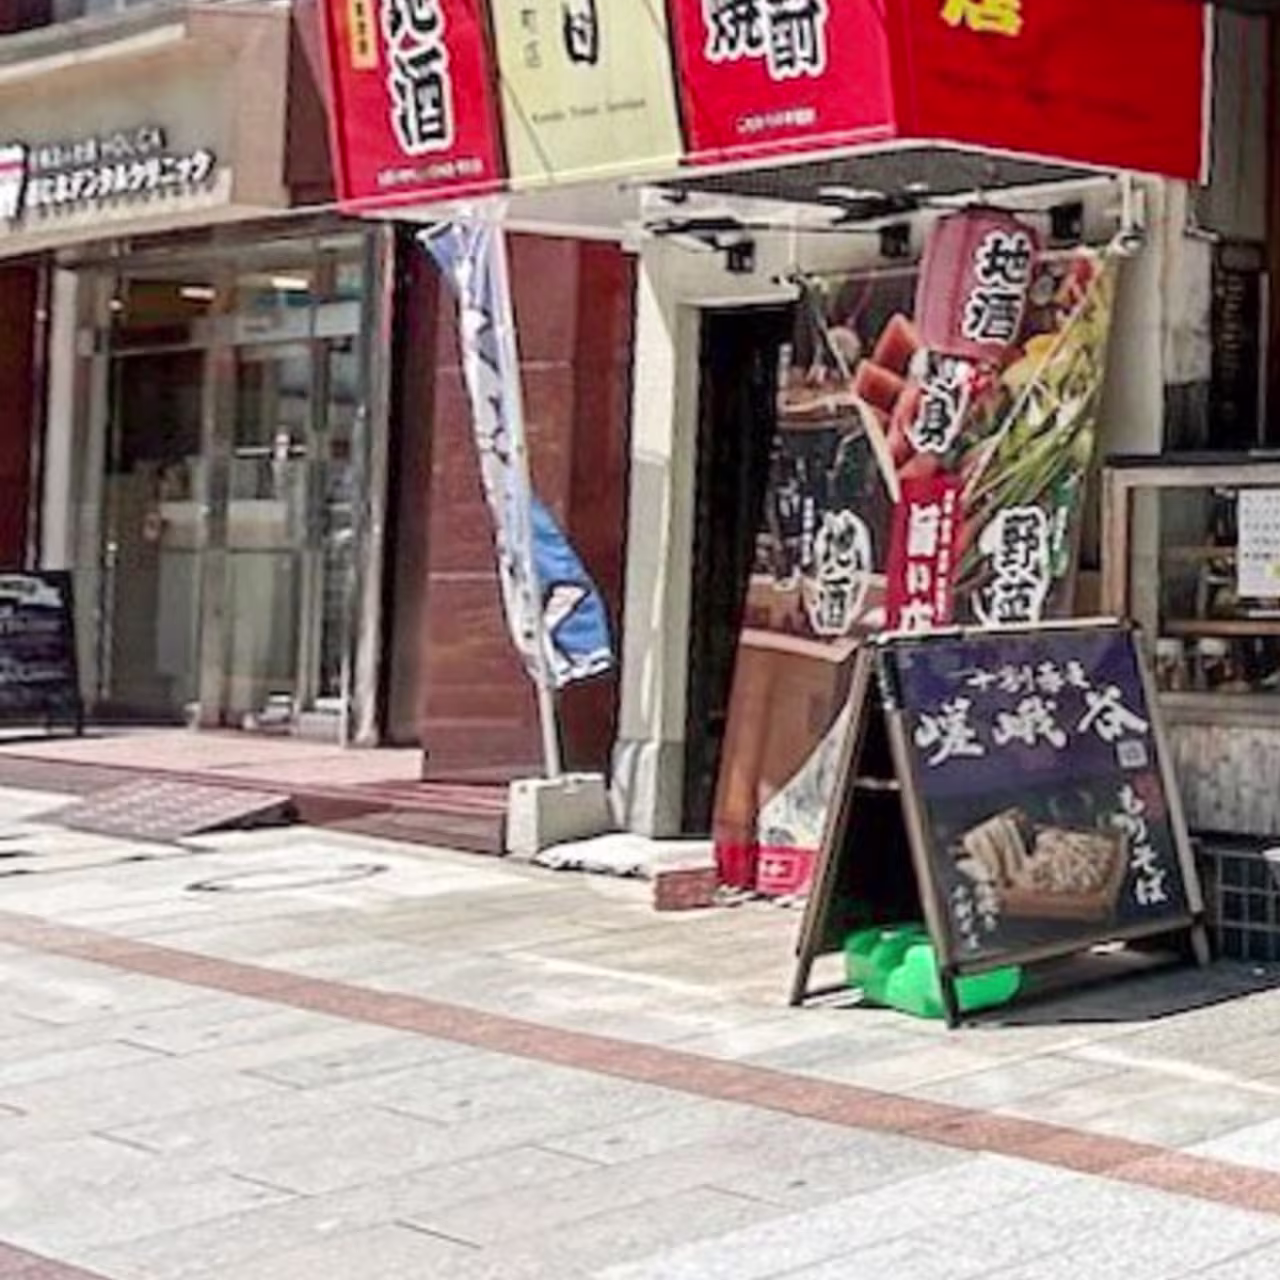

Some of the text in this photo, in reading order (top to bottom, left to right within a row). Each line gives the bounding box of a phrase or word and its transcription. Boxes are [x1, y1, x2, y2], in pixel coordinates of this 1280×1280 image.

[962, 231, 1033, 345] 地酒
[811, 510, 869, 634] 地酒
[915, 684, 1148, 767] 嵯峨谷
